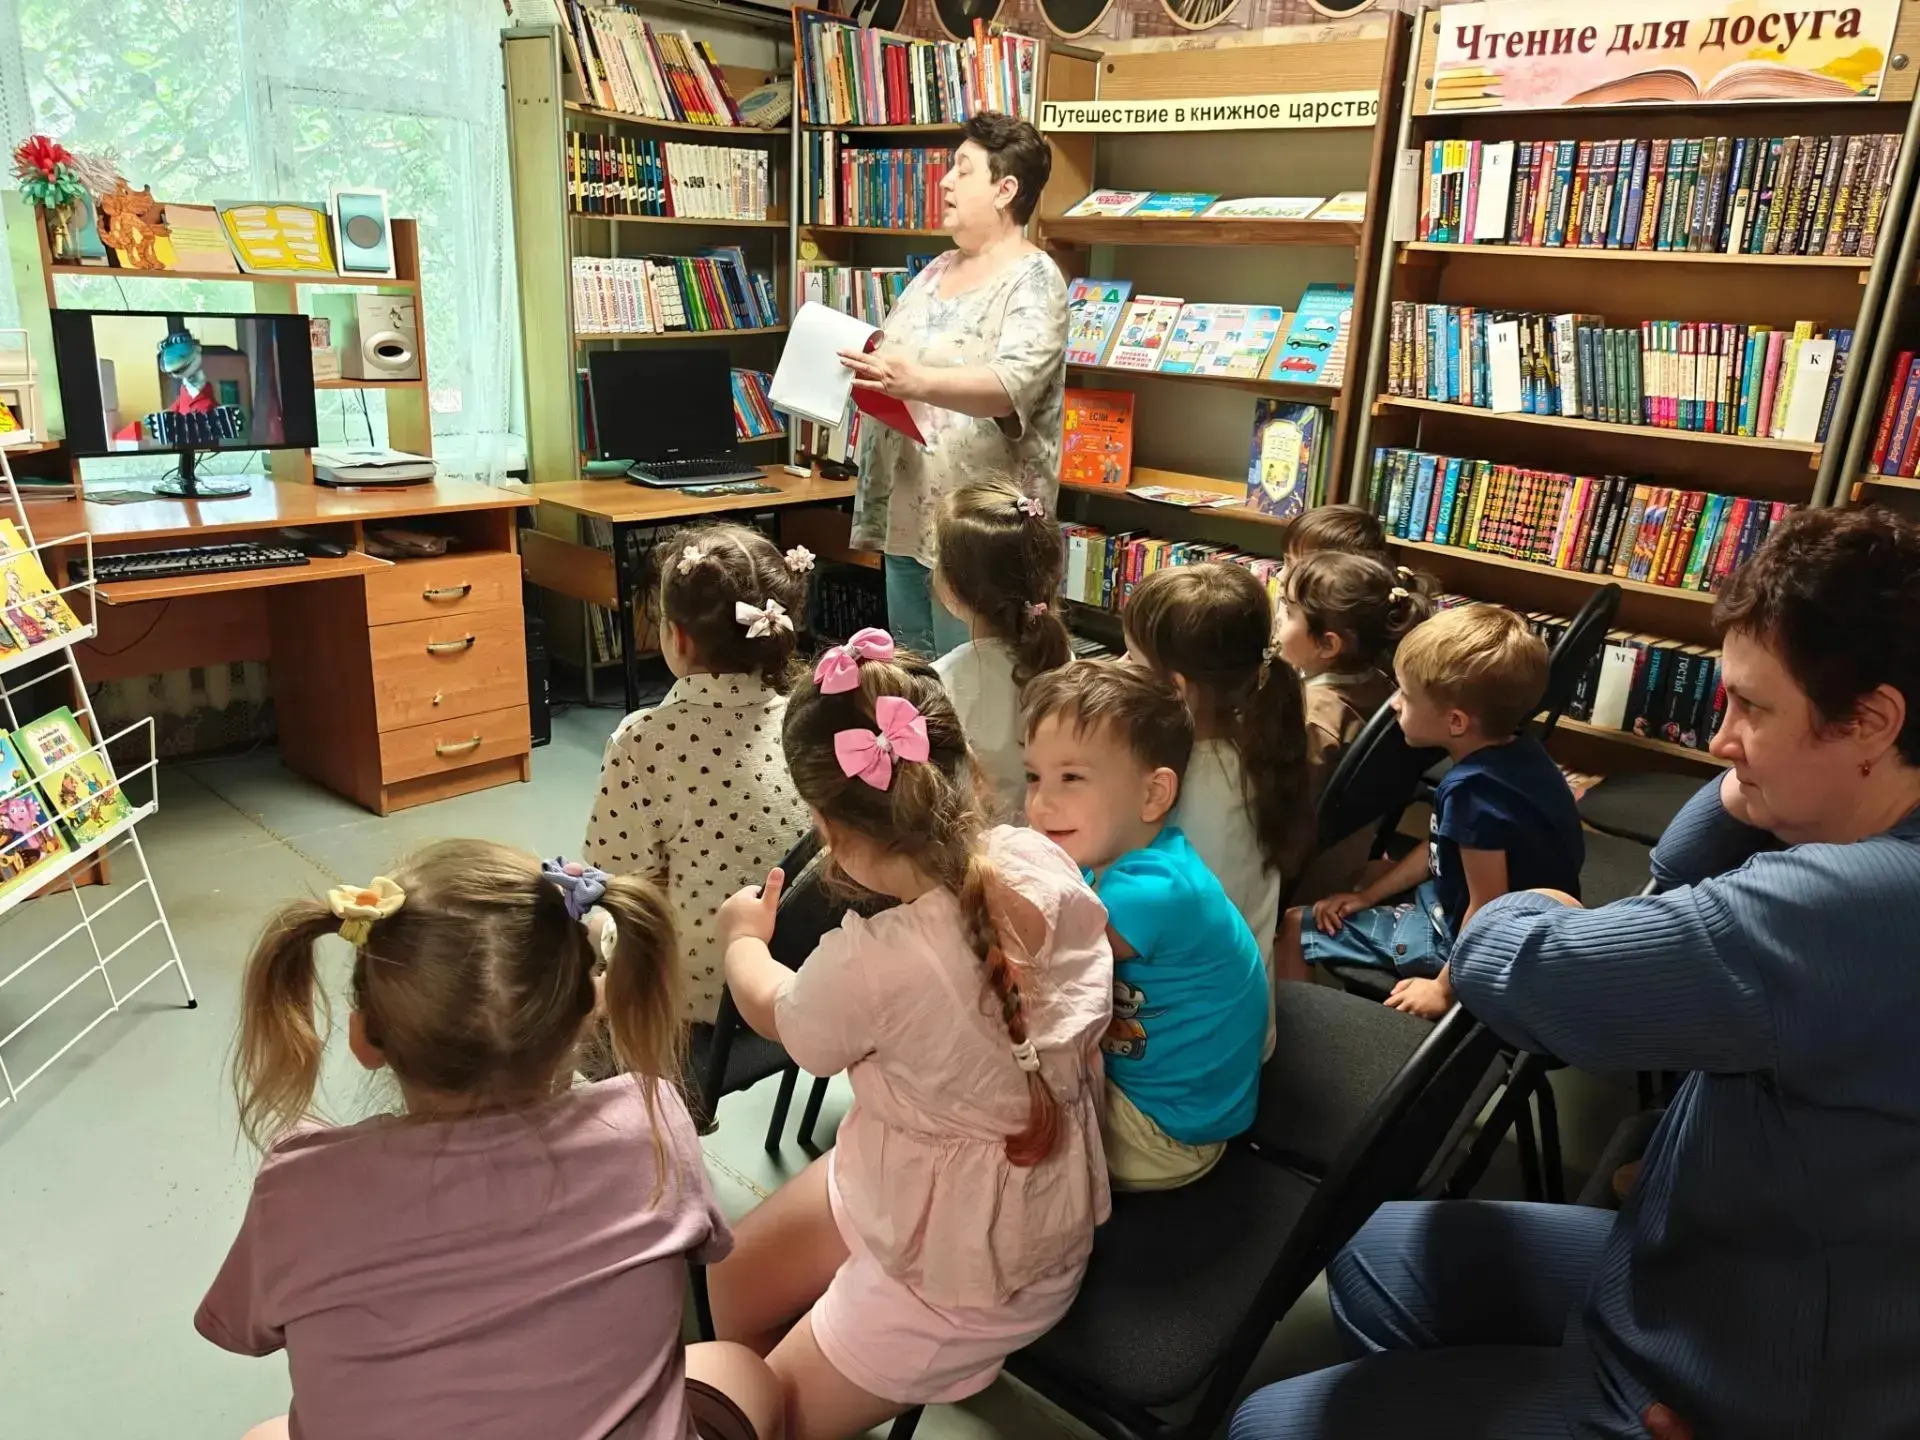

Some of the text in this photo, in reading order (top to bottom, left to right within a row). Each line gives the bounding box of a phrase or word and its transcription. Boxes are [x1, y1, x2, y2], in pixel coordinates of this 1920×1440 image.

[1456, 8, 1862, 60] Чтение для досуга
[1042, 103, 1169, 127] Путешествие
[1175, 107, 1185, 122] в
[1190, 102, 1280, 122] книжное
[811, 276, 820, 287] А
[1810, 353, 1821, 365] К
[1614, 651, 1626, 663] М
